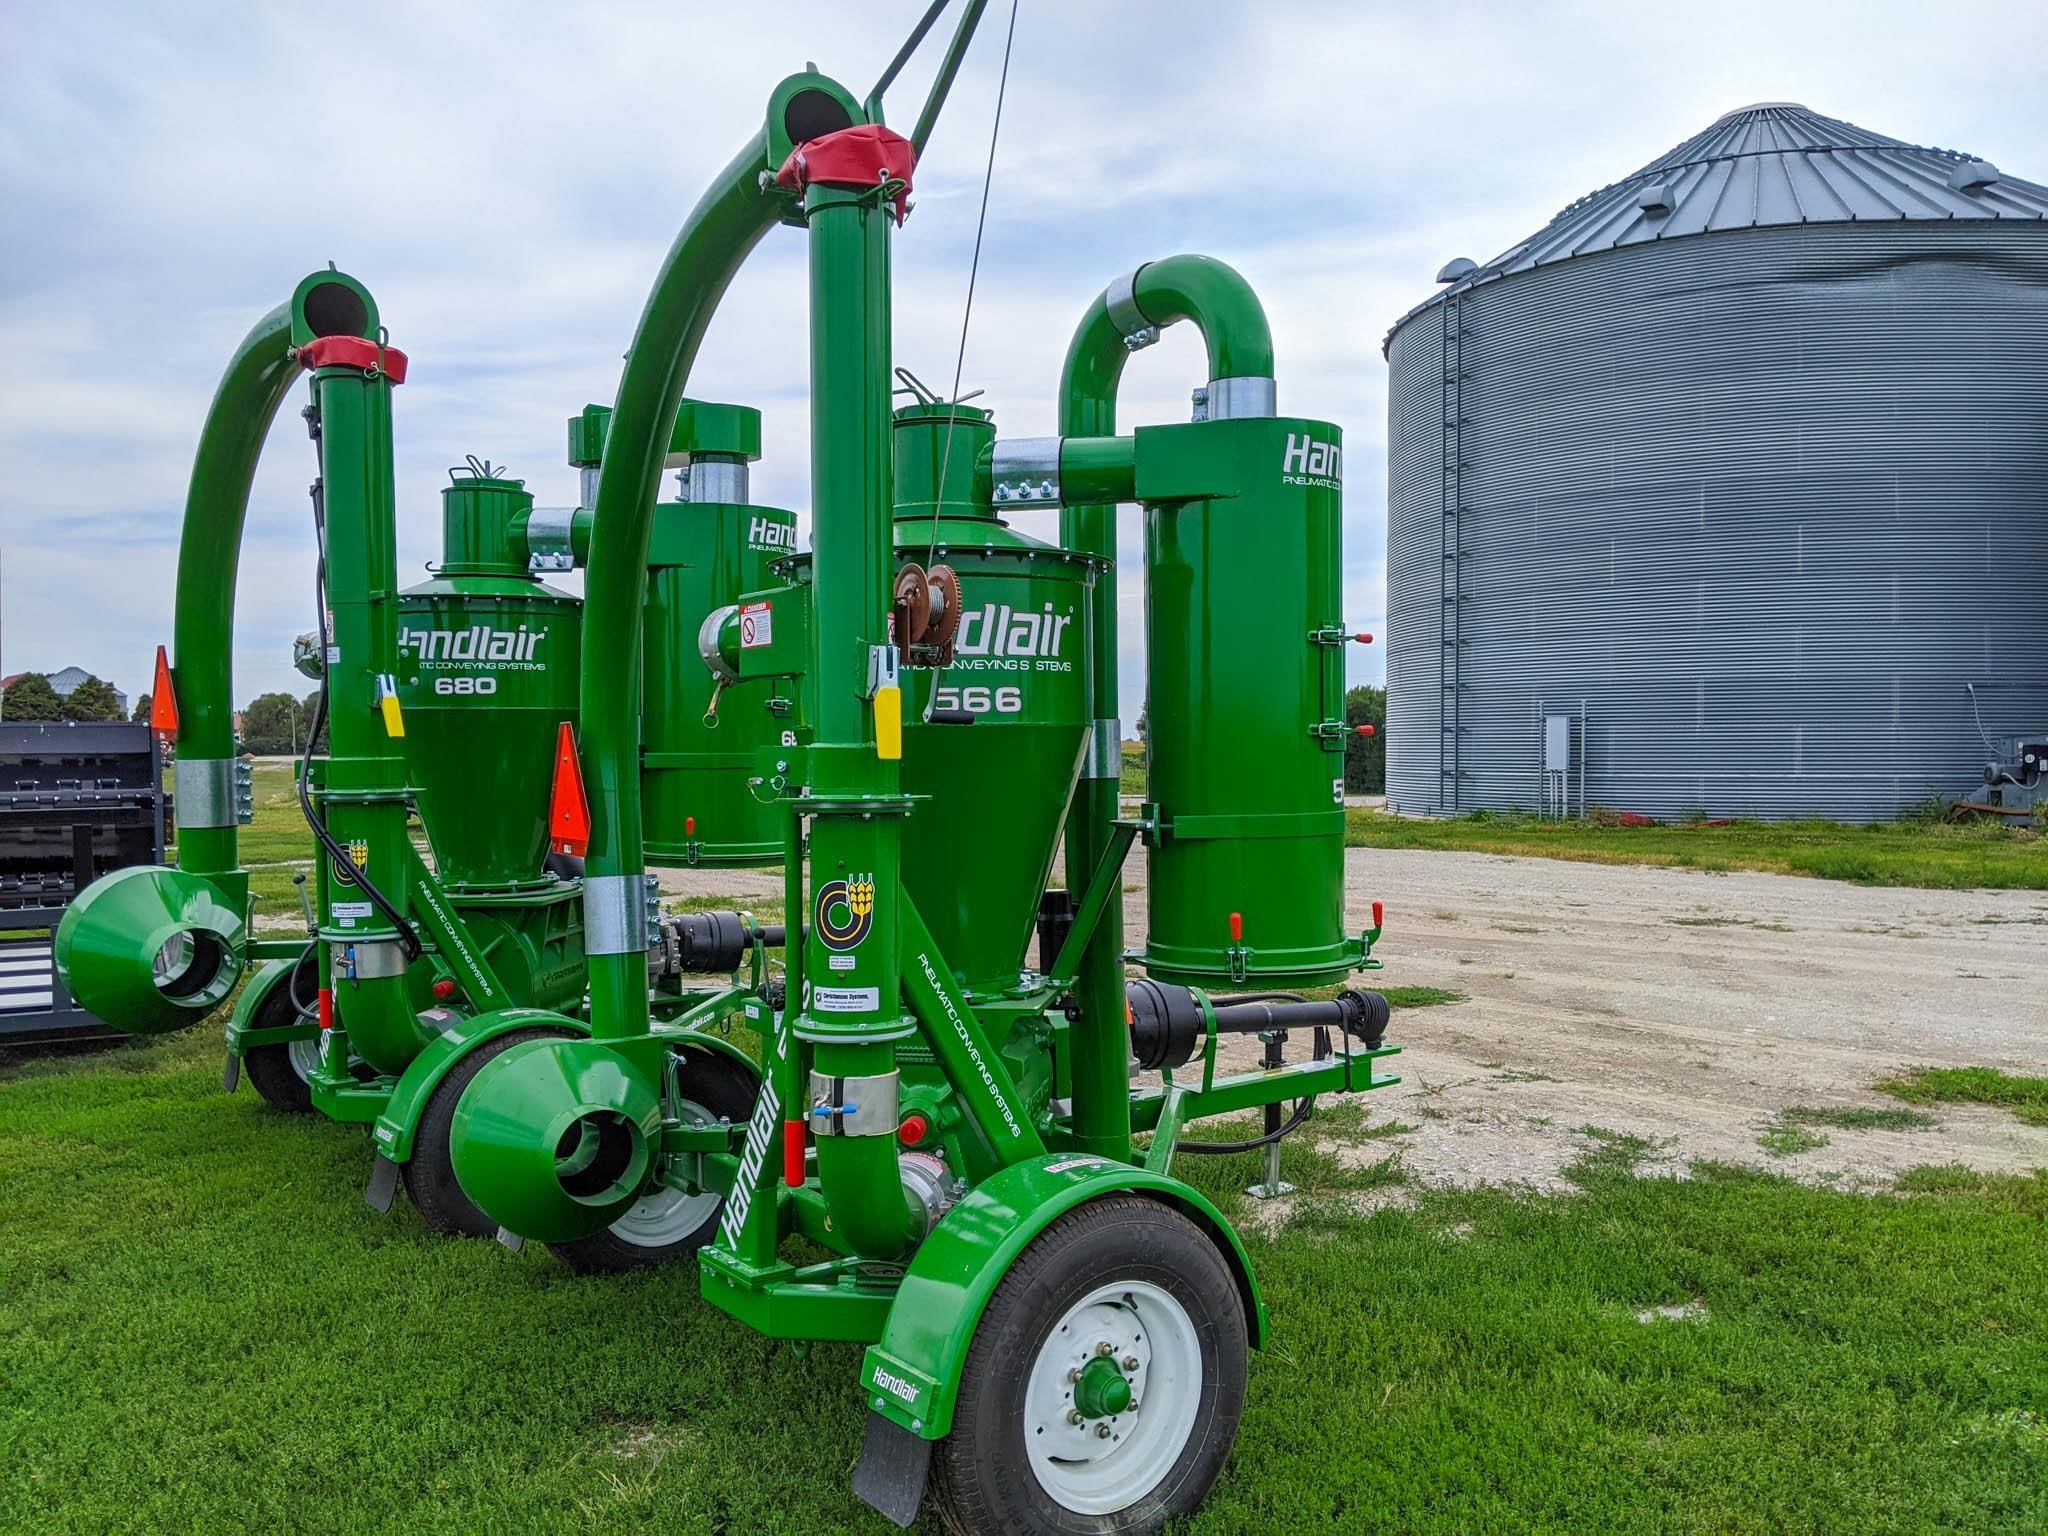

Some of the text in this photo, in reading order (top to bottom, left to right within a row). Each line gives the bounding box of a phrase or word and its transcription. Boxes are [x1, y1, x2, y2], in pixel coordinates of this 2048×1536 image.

[434, 677, 497, 695] 680
[435, 662, 497, 670] CONVEYING
[498, 662, 546, 671] SYSTEMS
[935, 686, 1022, 713] 566
[418, 880, 493, 997] PNEUMATIC CONVEYING SYSTEMS
[918, 953, 1021, 1138] PNEUMATIC CONVEYING SYSTEMS
[721, 1067, 781, 1252] Handlair
[872, 1365, 920, 1404] Handlair
